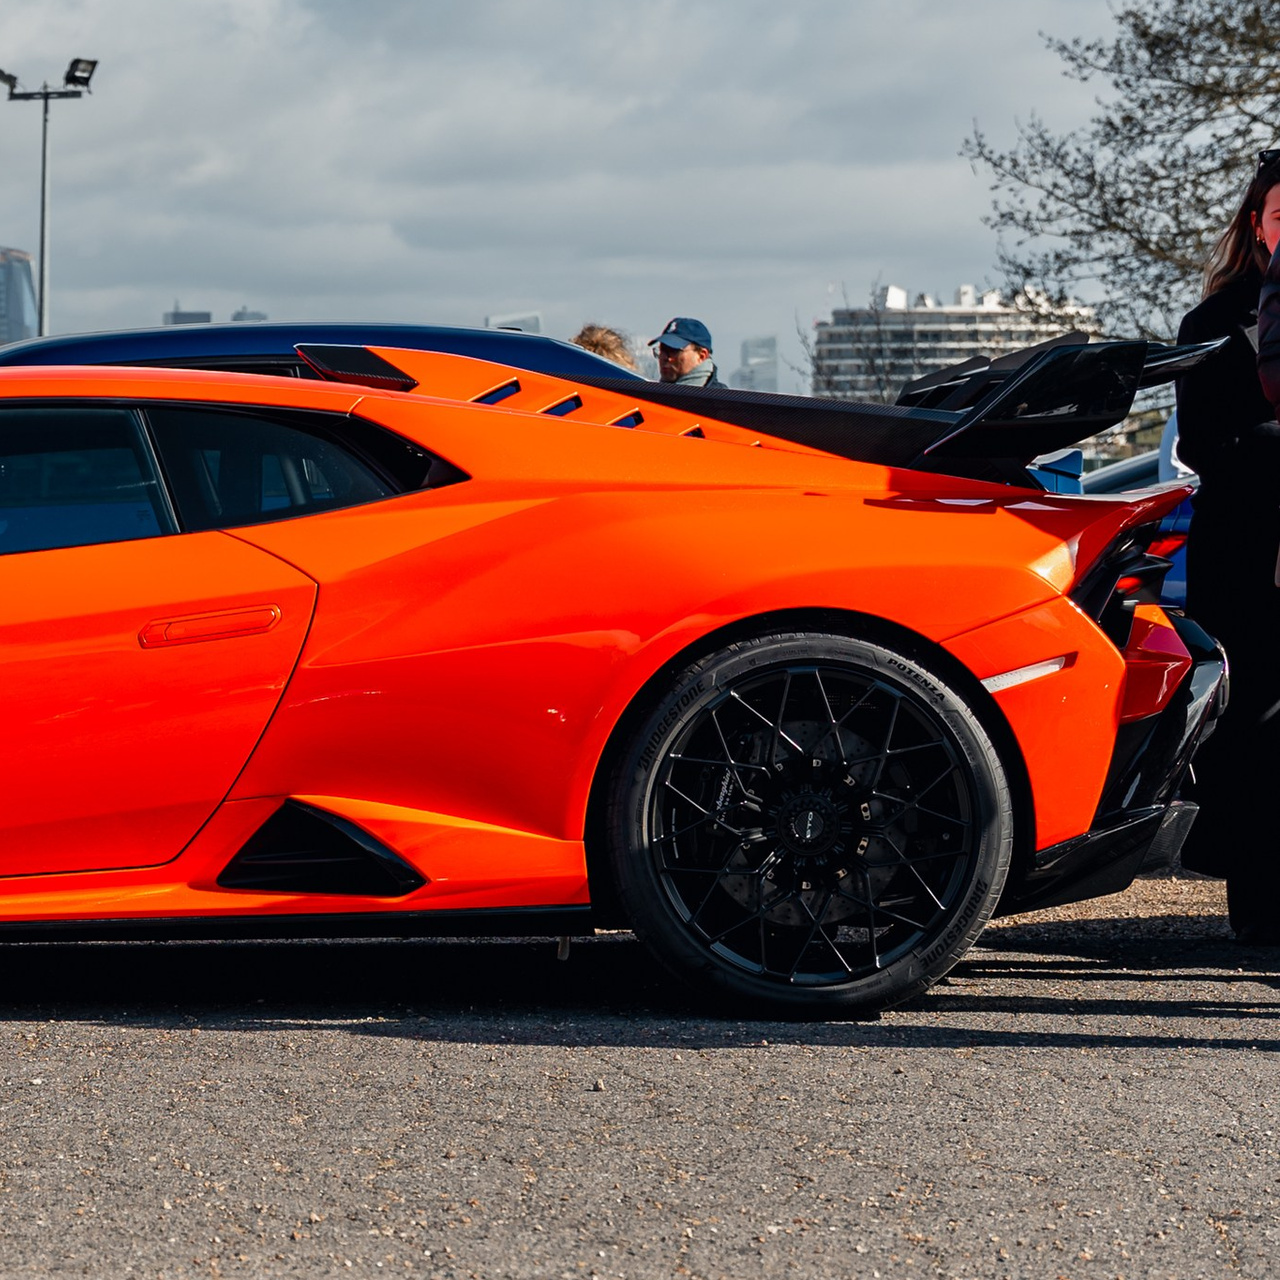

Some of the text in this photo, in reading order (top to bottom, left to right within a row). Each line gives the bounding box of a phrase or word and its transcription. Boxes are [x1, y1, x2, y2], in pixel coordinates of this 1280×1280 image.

[887, 658, 945, 702] POTENZA
[639, 680, 706, 772] BRIDGESTONE
[806, 811, 814, 839] STO
[921, 879, 988, 969] BRIDGESTONE
